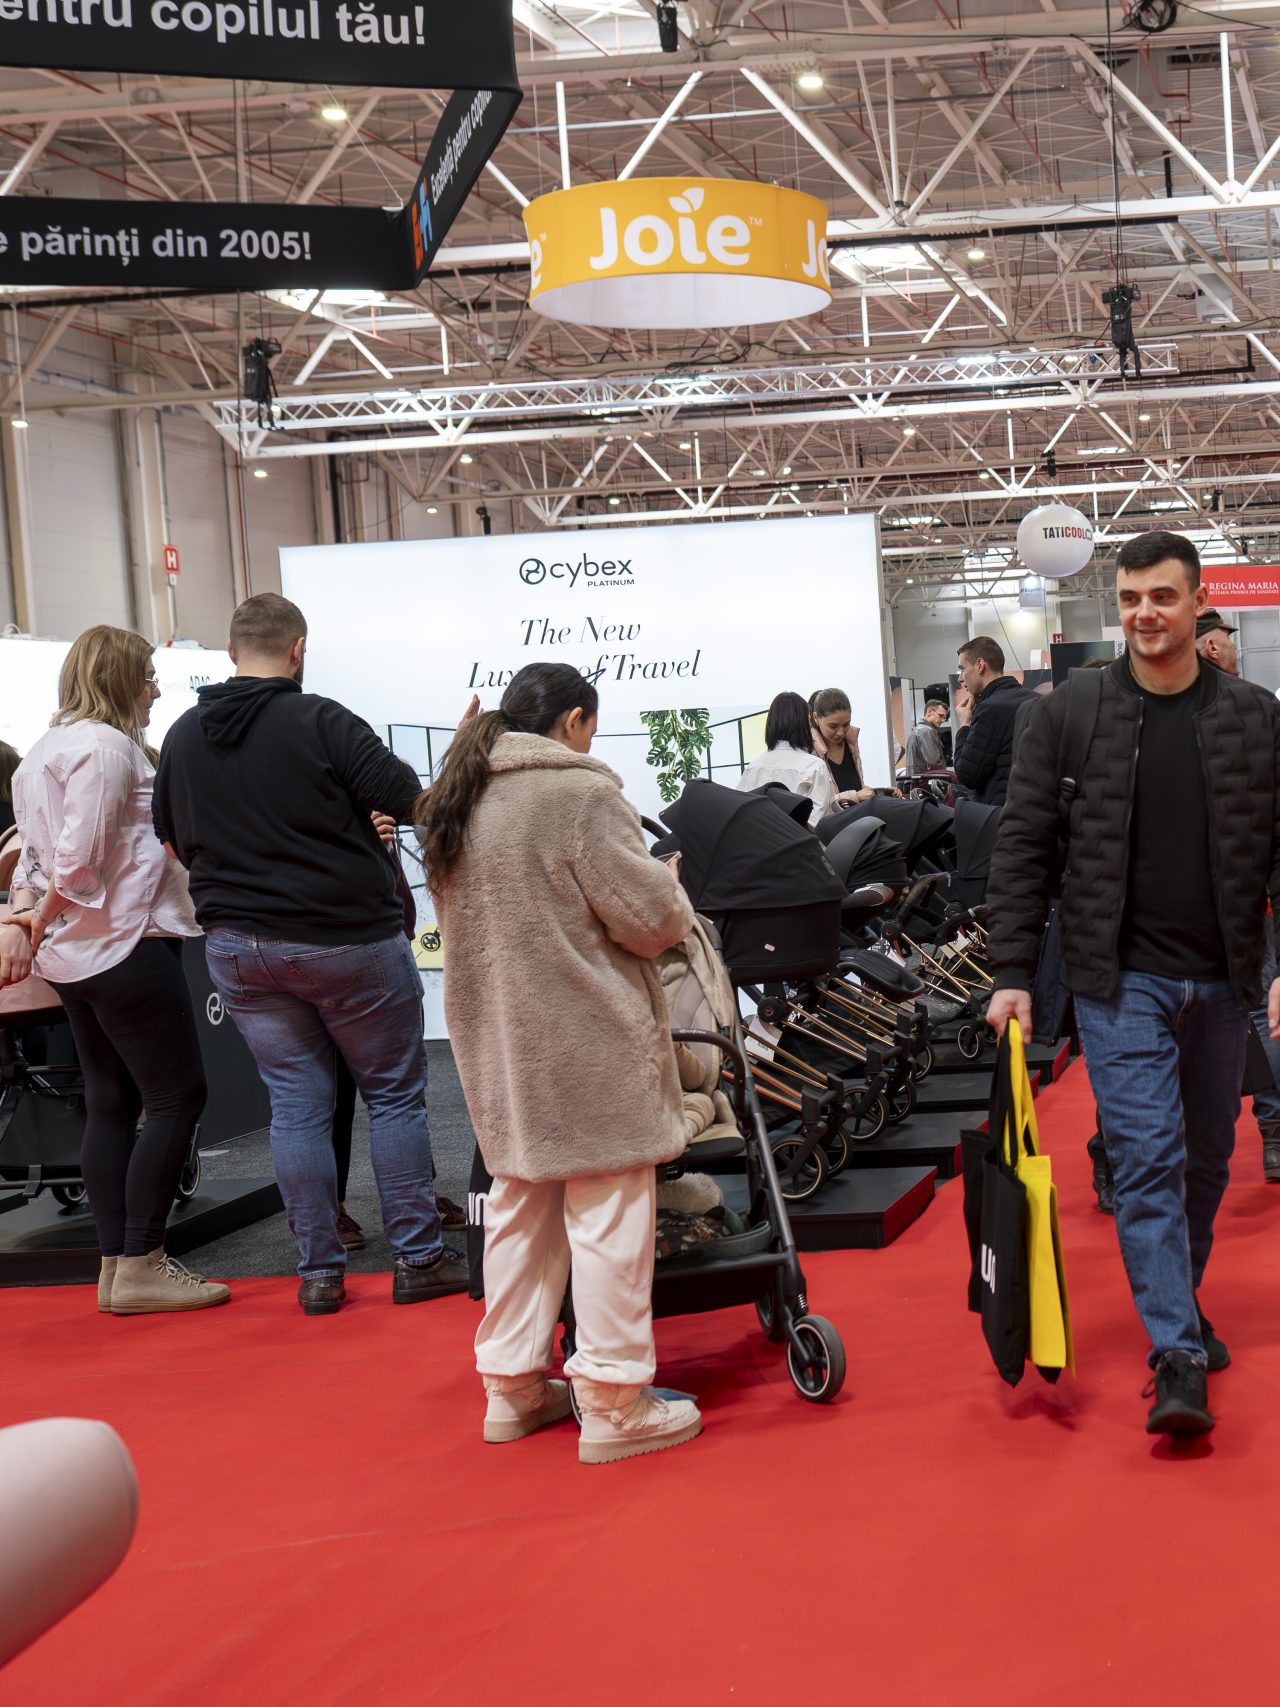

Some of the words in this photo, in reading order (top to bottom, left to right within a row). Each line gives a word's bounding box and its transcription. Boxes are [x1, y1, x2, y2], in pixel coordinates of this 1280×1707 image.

[0, 0, 133, 28] entru
[151, 0, 320, 43] copilul
[335, 3, 427, 45] tău!
[589, 187, 750, 271] Joie
[20, 224, 140, 267] părinți
[152, 228, 208, 259] din
[219, 229, 312, 261] 2005!
[1043, 526, 1086, 540] TATICOOL
[166, 550, 177, 570] H
[550, 553, 633, 588] cybex
[587, 579, 635, 587] PLATINUM
[1209, 582, 1245, 590] REGINA
[1248, 581, 1279, 590] MARIA
[520, 617, 571, 646] The
[578, 616, 641, 643] New
[466, 661, 518, 688] Lux
[611, 649, 701, 681] Travel
